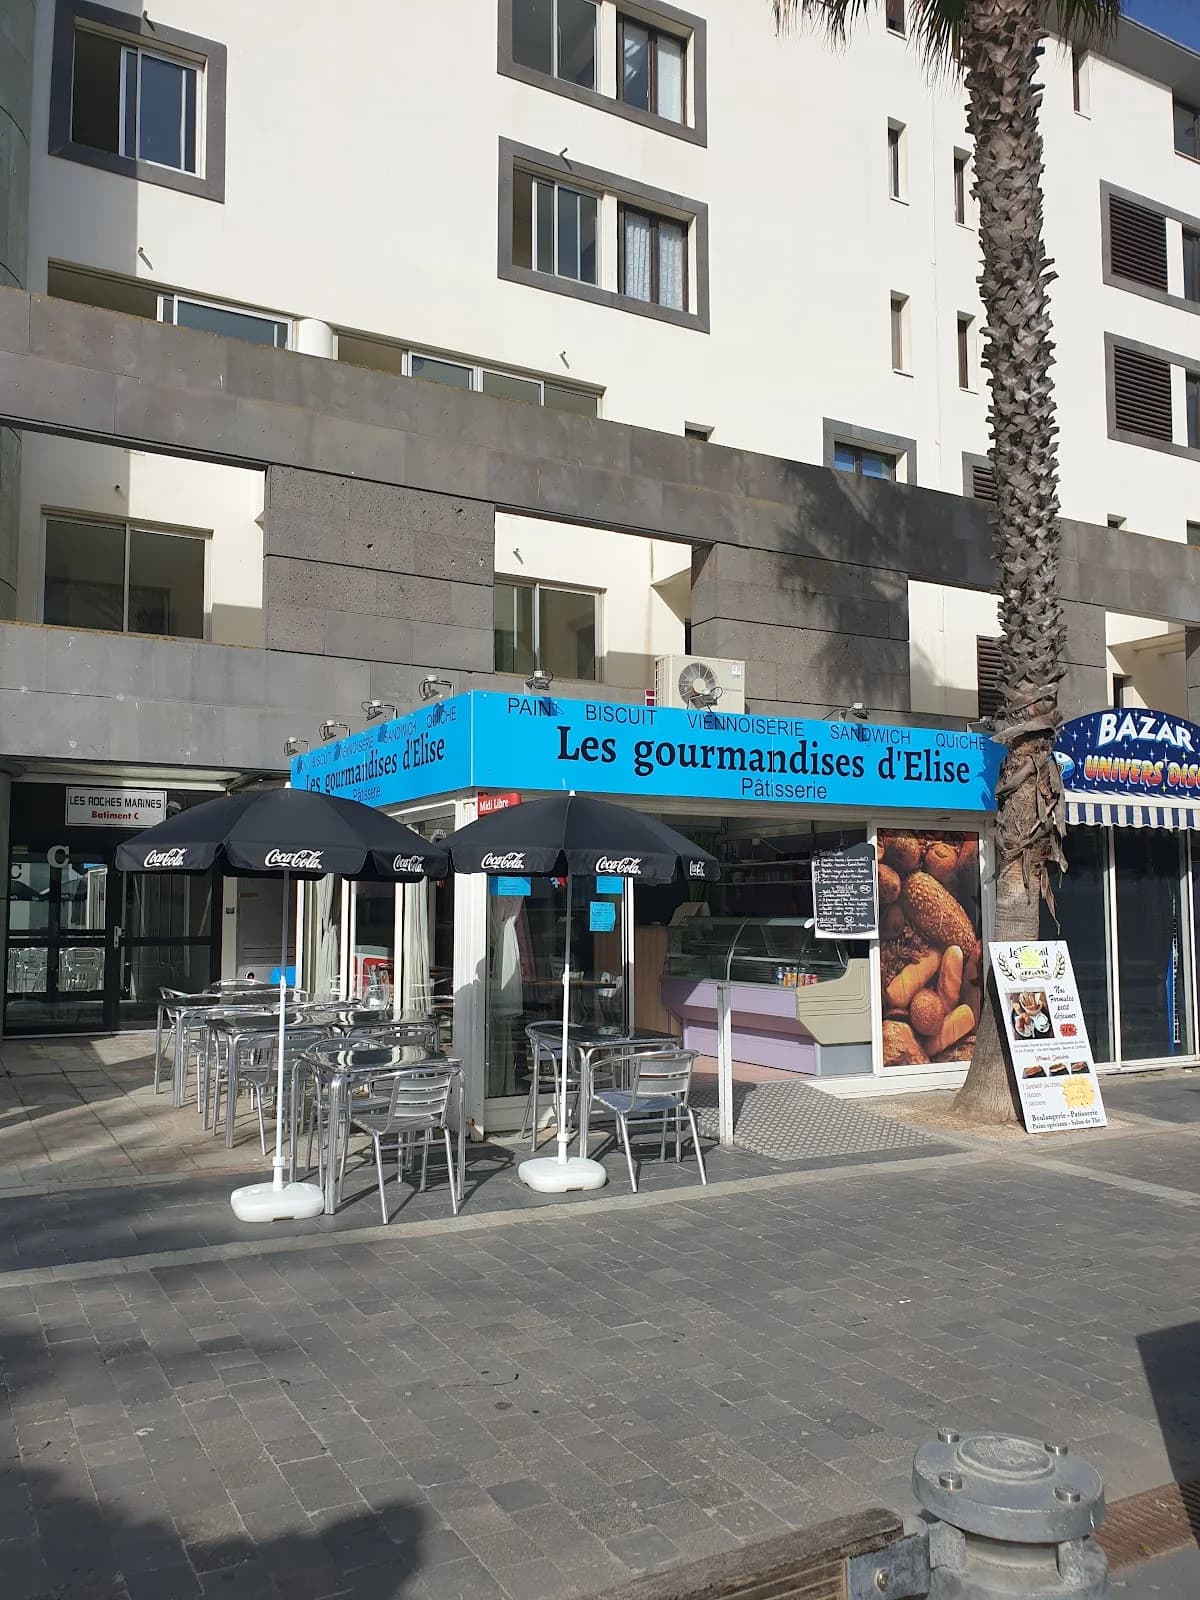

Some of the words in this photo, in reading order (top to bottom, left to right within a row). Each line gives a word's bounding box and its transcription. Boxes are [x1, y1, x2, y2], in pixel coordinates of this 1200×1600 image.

[507, 697, 551, 716] PAIN
[586, 704, 657, 726] BISCUIT
[687, 712, 805, 736] VIENNOISERIE
[830, 724, 911, 745] SANDWICH
[935, 732, 987, 751] QUICHE
[1098, 712, 1195, 752] BAZAR
[325, 750, 398, 796] gourmandises
[402, 733, 445, 771] d'Elise
[557, 725, 616, 763] Les
[634, 739, 865, 777] gourmandises
[878, 747, 970, 784] d'Elise
[1084, 755, 1164, 787] UNIVERS
[1167, 761, 1200, 789] DIS
[69, 796, 85, 806] LES
[88, 796, 122, 807] ROCHES
[124, 799, 162, 809] MARINES
[741, 778, 827, 799] Pâtisserie
[91, 811, 131, 820] Batiment
[133, 812, 139, 820] C
[479, 801, 492, 811] Midi
[493, 798, 509, 808] Libre
[47, 845, 70, 868] C
